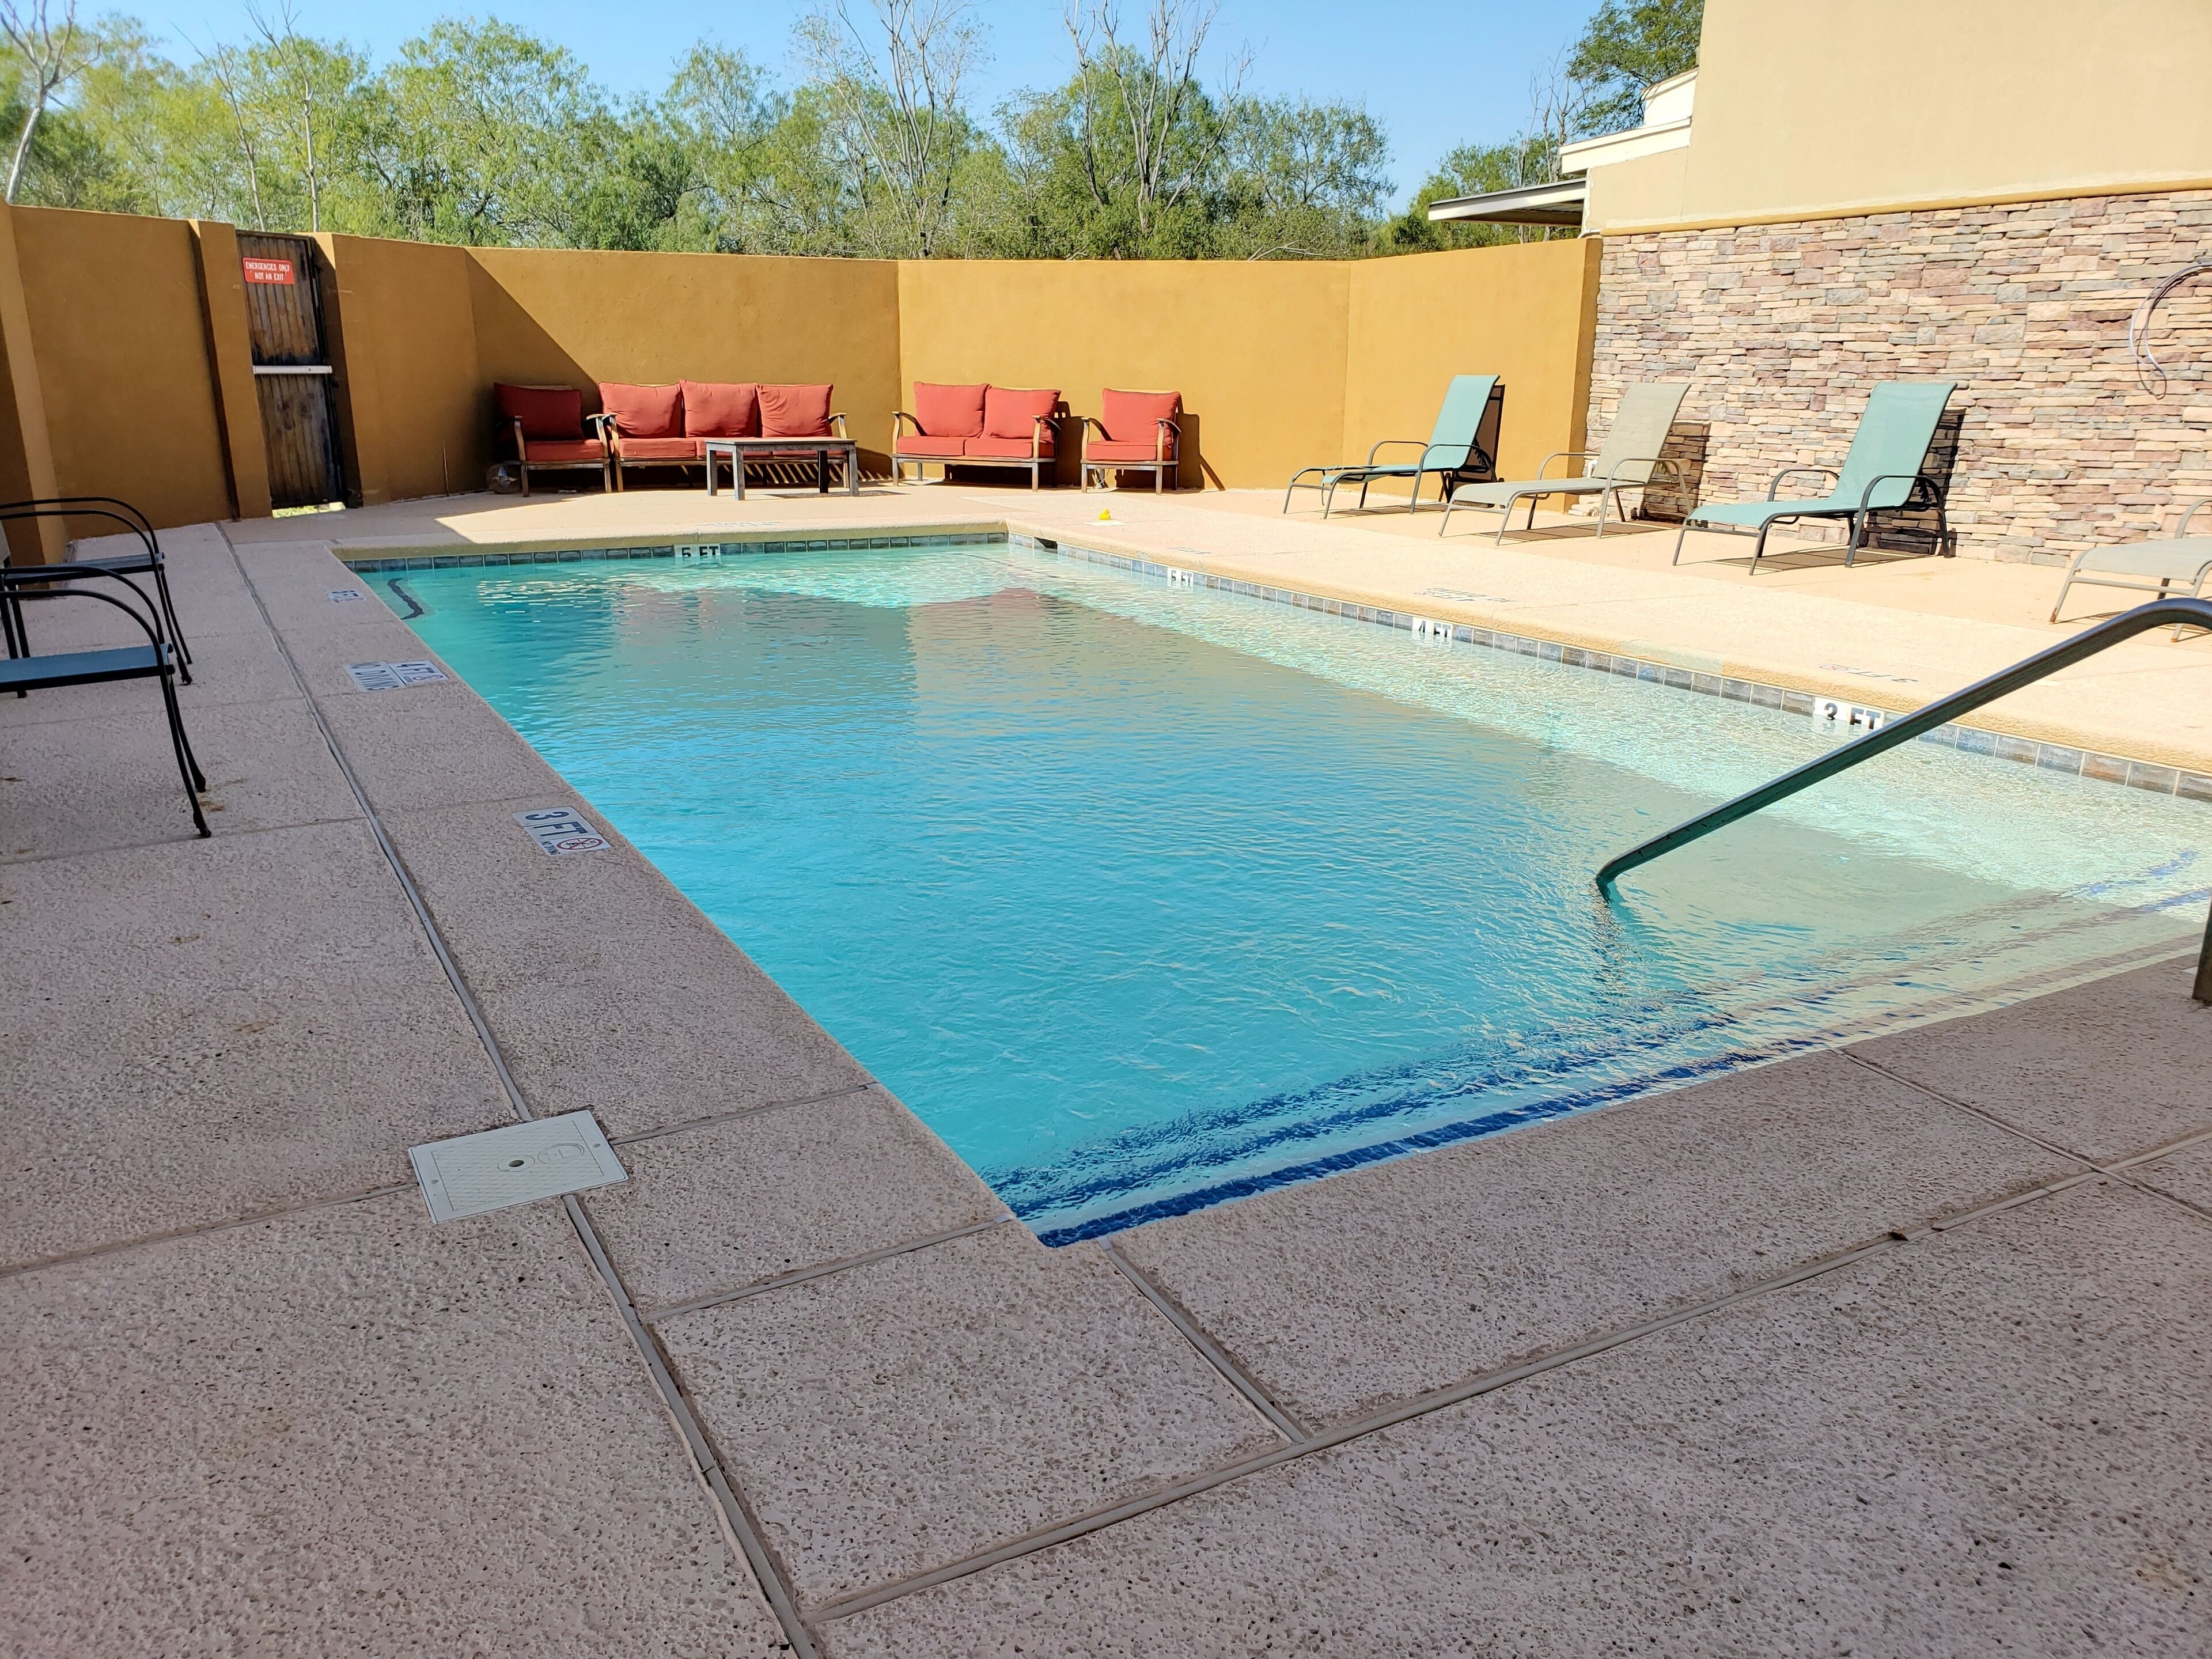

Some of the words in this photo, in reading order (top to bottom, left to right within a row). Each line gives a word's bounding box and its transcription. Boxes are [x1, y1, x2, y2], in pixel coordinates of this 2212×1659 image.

[245, 262, 276, 271] EMERGENCIES
[279, 263, 289, 272] ONLY
[255, 272, 264, 280] NOT
[274, 273, 283, 281] EXIT
[681, 547, 691, 556] 5
[699, 546, 718, 556] FT
[1433, 623, 1450, 638] FT
[355, 670, 399, 691] DIVING
[1850, 707, 1881, 730] FT
[525, 811, 570, 820] 3
[533, 821, 588, 836] FT
